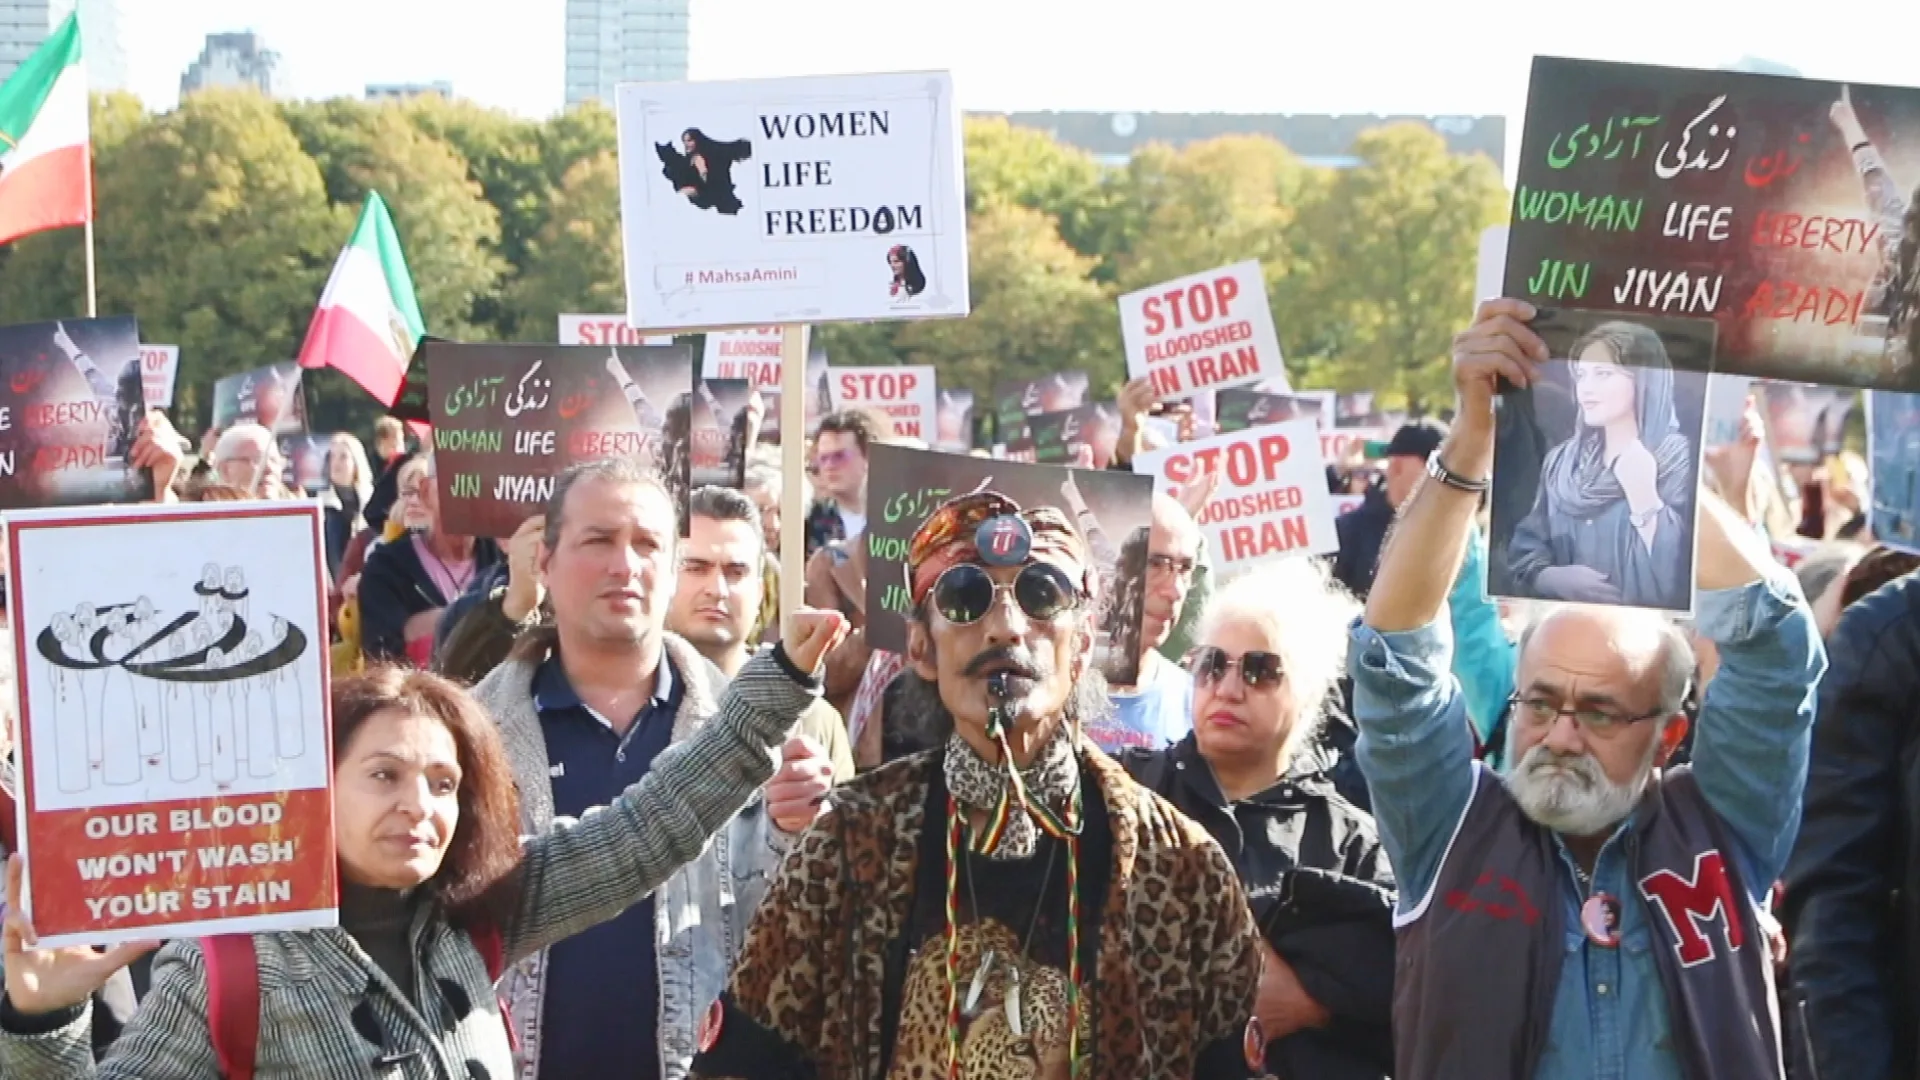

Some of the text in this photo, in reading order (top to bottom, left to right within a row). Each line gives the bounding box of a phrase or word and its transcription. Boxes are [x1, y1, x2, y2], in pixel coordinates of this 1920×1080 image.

[760, 110, 890, 140] WOMEN
[763, 160, 833, 188] LIFE
[1518, 184, 1880, 255] WOMAN LIFE LIBERTY
[1142, 276, 1239, 337] STOP
[1527, 258, 1865, 326] JIN JIYAN AZADI
[577, 322, 644, 345] STO
[1144, 320, 1253, 365] BLOODSHED
[841, 373, 918, 401] STOP
[1149, 344, 1261, 398] IN IRAN
[434, 427, 504, 452] WOMAN
[514, 430, 557, 456] LIFE
[450, 474, 556, 504] JIN JIYAN
[1220, 515, 1310, 563] IRAN
[84, 799, 283, 841] OUR BLOOD
[76, 839, 294, 882] WON'T WASH
[84, 878, 292, 922] YOUR STAIN
[1638, 848, 1746, 968] M
